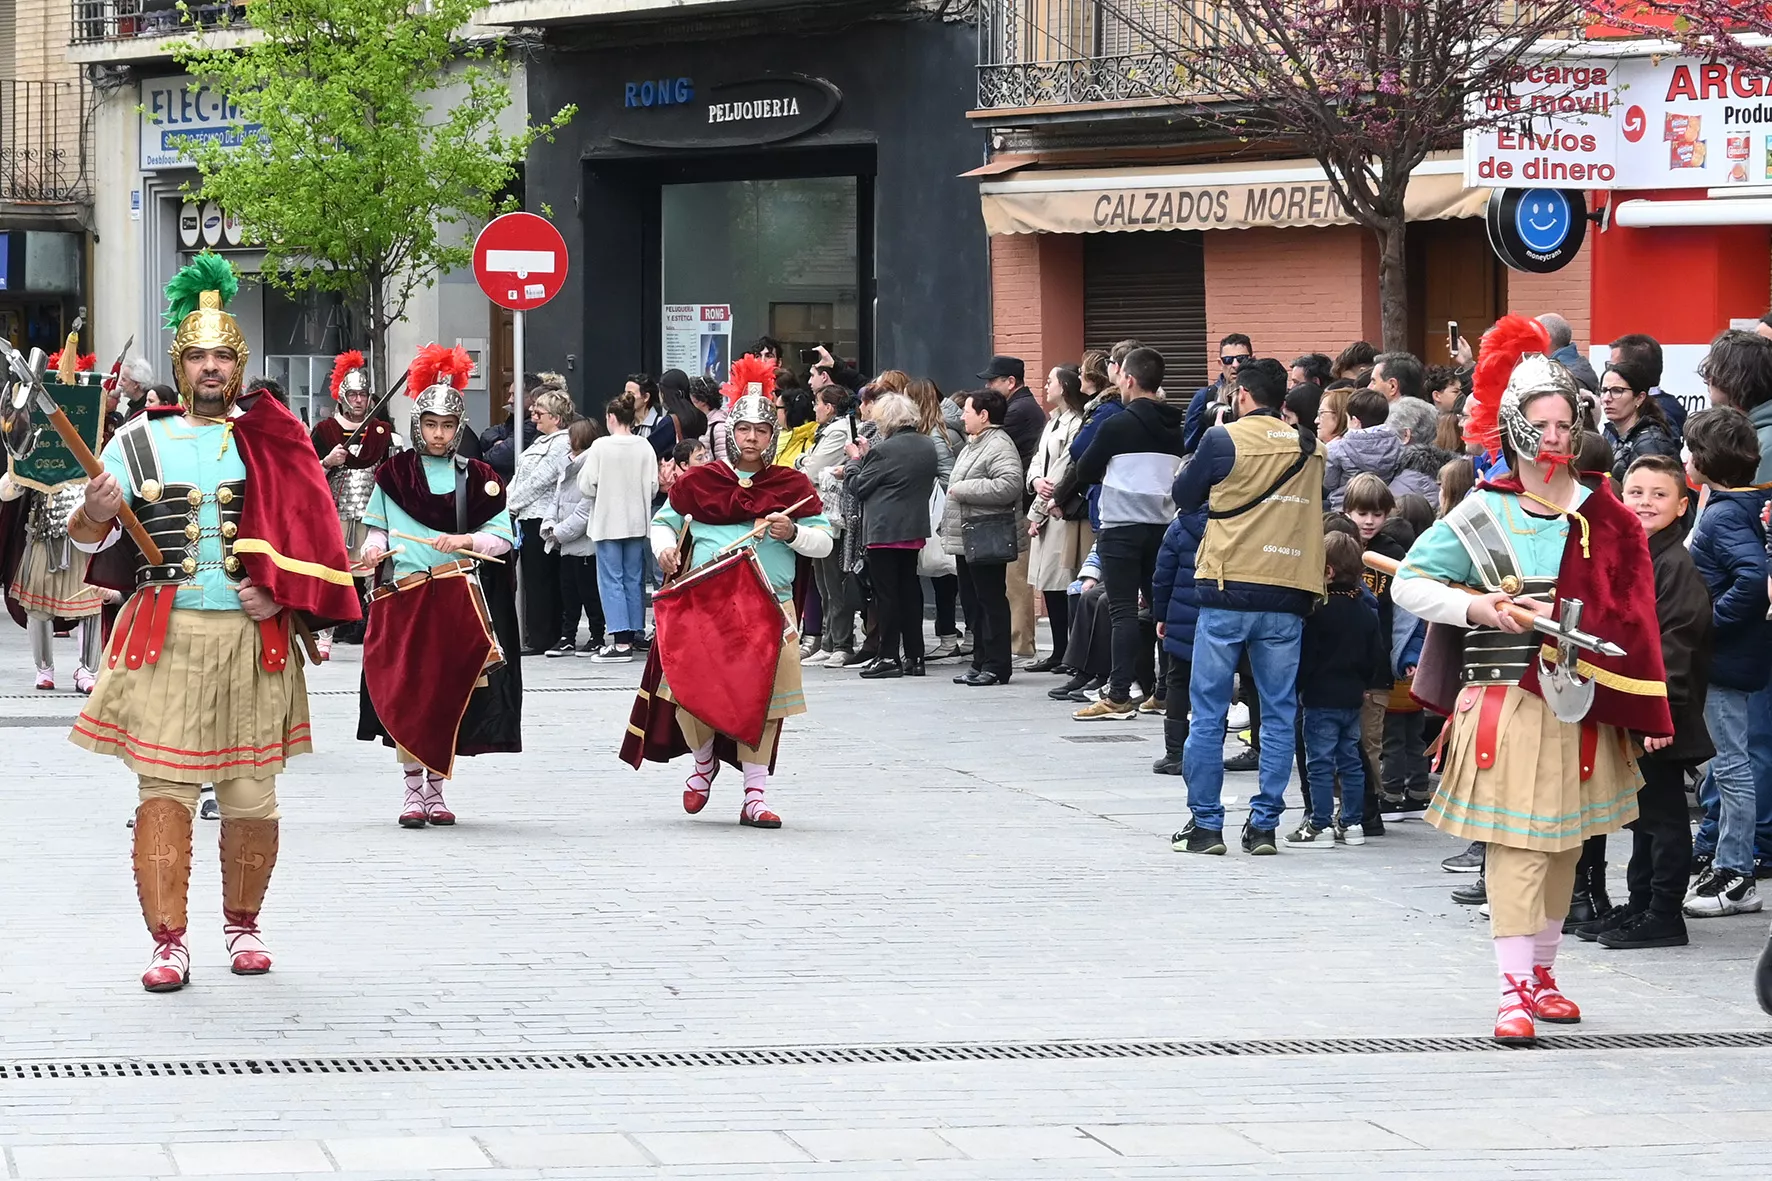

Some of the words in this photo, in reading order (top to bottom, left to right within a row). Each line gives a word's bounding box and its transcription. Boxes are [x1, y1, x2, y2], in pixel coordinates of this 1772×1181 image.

[1489, 59, 1607, 90] ecarga
[1665, 62, 1772, 102] ARG
[625, 78, 693, 107] RONG
[708, 97, 800, 123] PELUQUERIA
[1498, 127, 1597, 152] Envíos
[1478, 156, 1513, 179] de
[1522, 157, 1615, 181] dinero
[1093, 190, 1229, 227] CALZADOS
[1244, 185, 1346, 222] MOREN
[1526, 249, 1562, 262] moneytrans
[705, 308, 725, 320] RONG
[35, 459, 67, 469] OSCA
[1263, 544, 1277, 553] 650
[1278, 546, 1290, 555] 408
